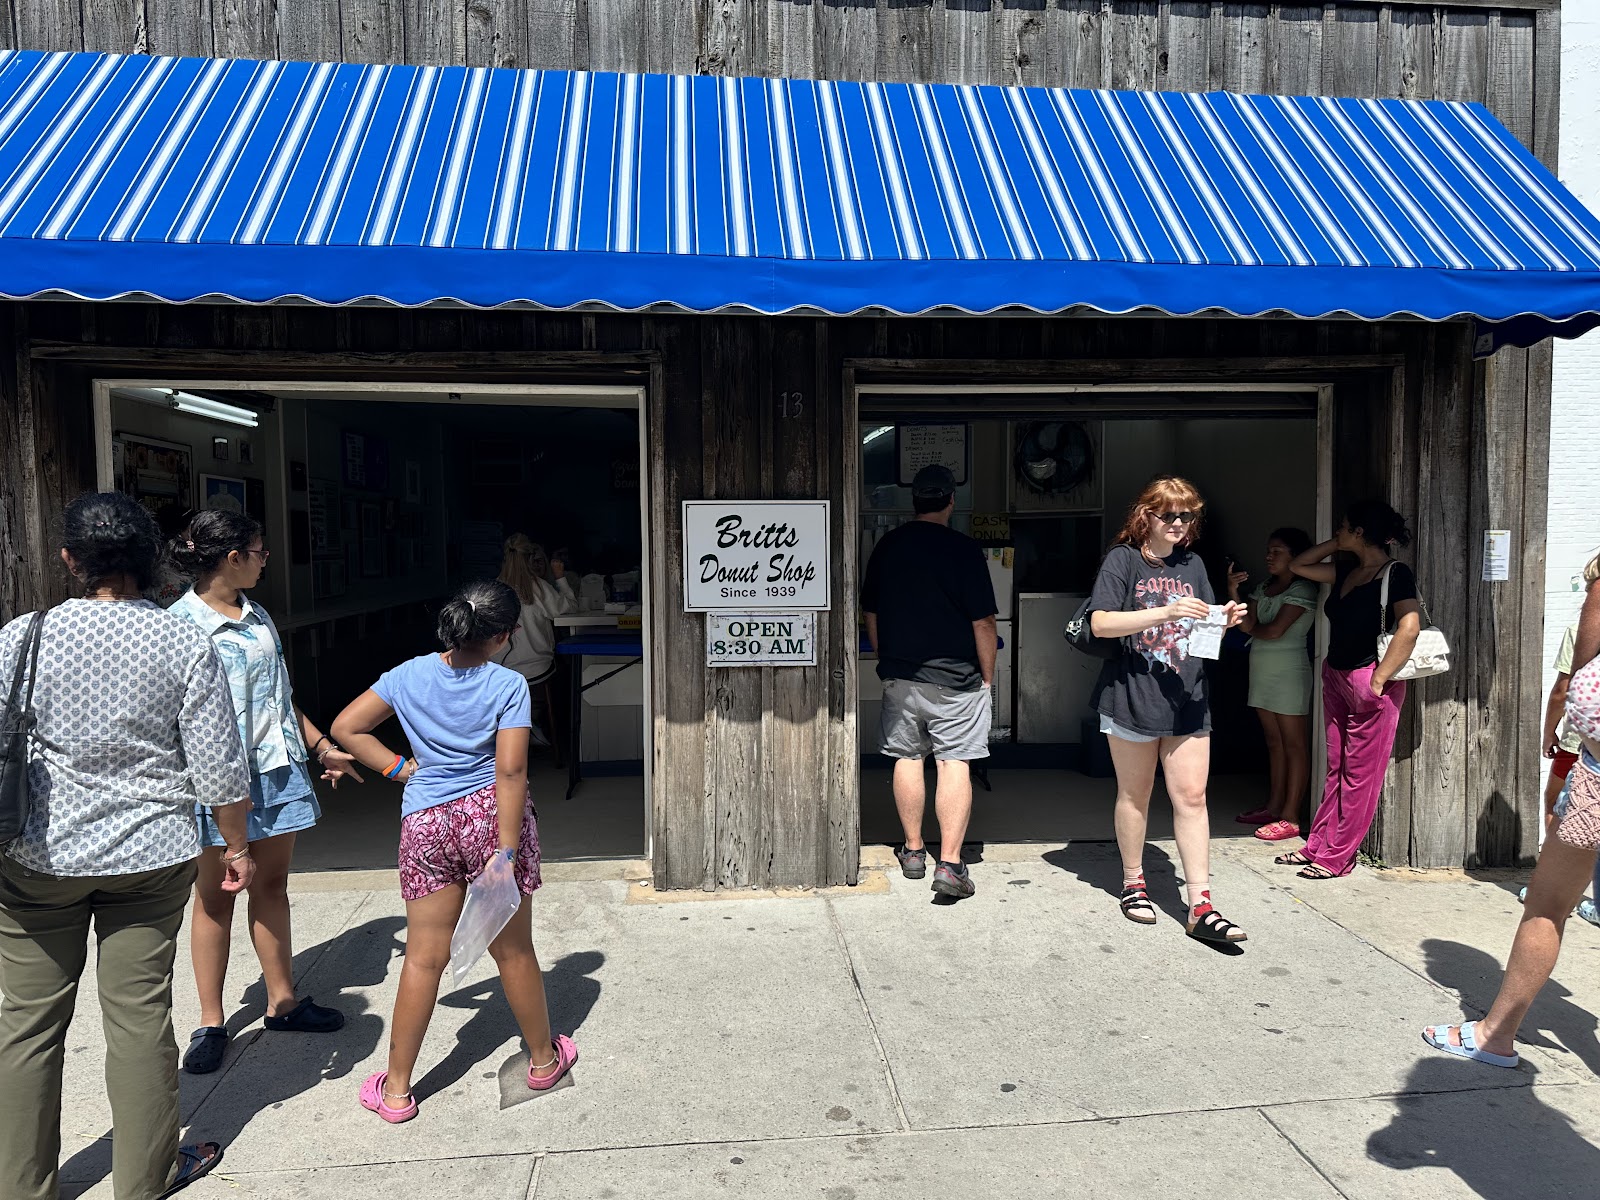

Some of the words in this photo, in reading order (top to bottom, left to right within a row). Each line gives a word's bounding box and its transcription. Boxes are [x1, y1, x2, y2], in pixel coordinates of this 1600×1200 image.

[780, 391, 803, 418] 13
[972, 516, 1008, 526] CASH
[715, 514, 799, 548] Britts
[973, 530, 1008, 540] ONLY
[699, 553, 760, 583] Donut
[766, 553, 816, 589] Shop
[720, 587, 757, 598] Since
[765, 586, 796, 597] 1939
[728, 621, 793, 637] OPEN
[713, 640, 761, 655] 8:30
[768, 639, 806, 654] AM
